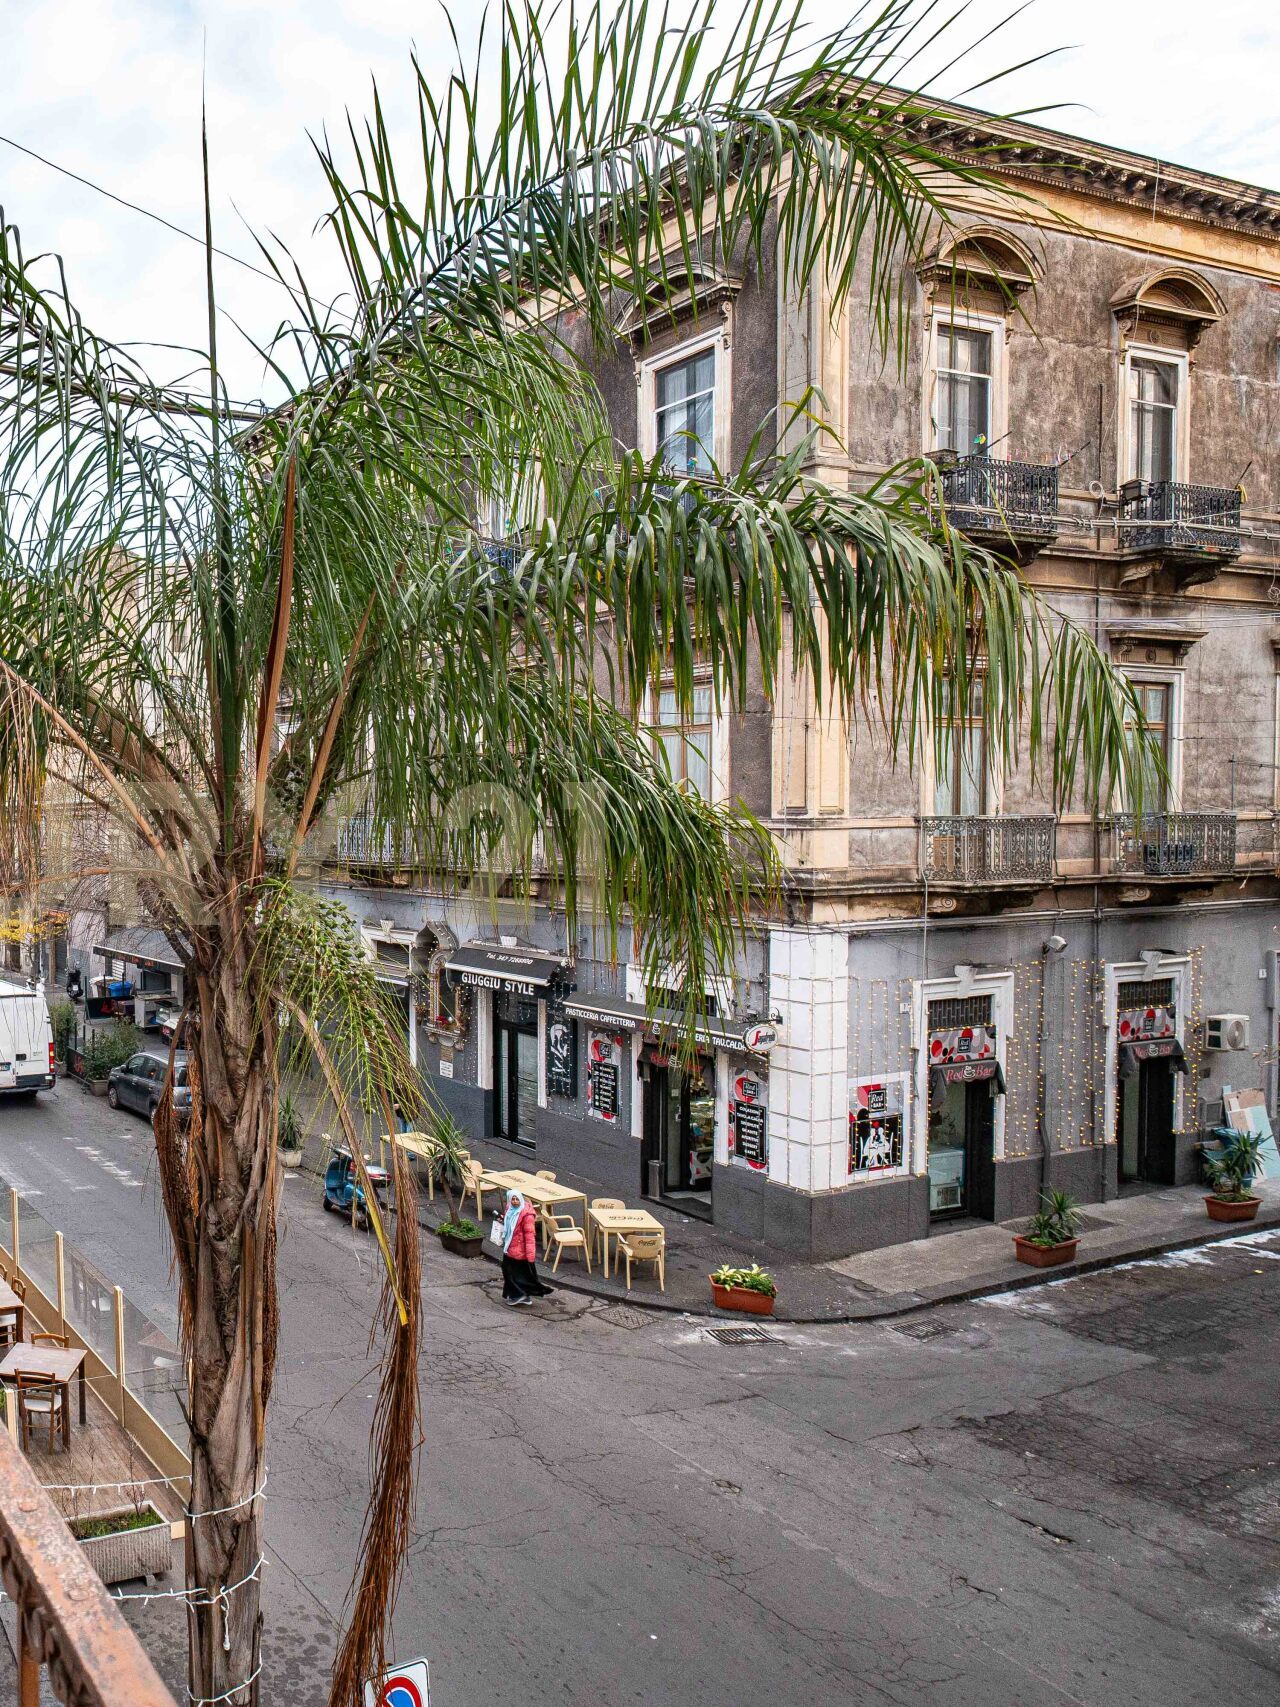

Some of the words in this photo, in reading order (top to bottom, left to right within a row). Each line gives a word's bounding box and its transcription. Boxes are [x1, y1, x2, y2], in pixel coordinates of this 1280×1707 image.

[461, 973, 500, 989] GIUGGIU
[504, 980, 535, 996] STYLE
[565, 1007, 599, 1021] PASTICCERIA
[600, 1014, 636, 1028] CAFFETTERIA
[946, 1067, 964, 1081] Red
[975, 1064, 994, 1077] Bar
